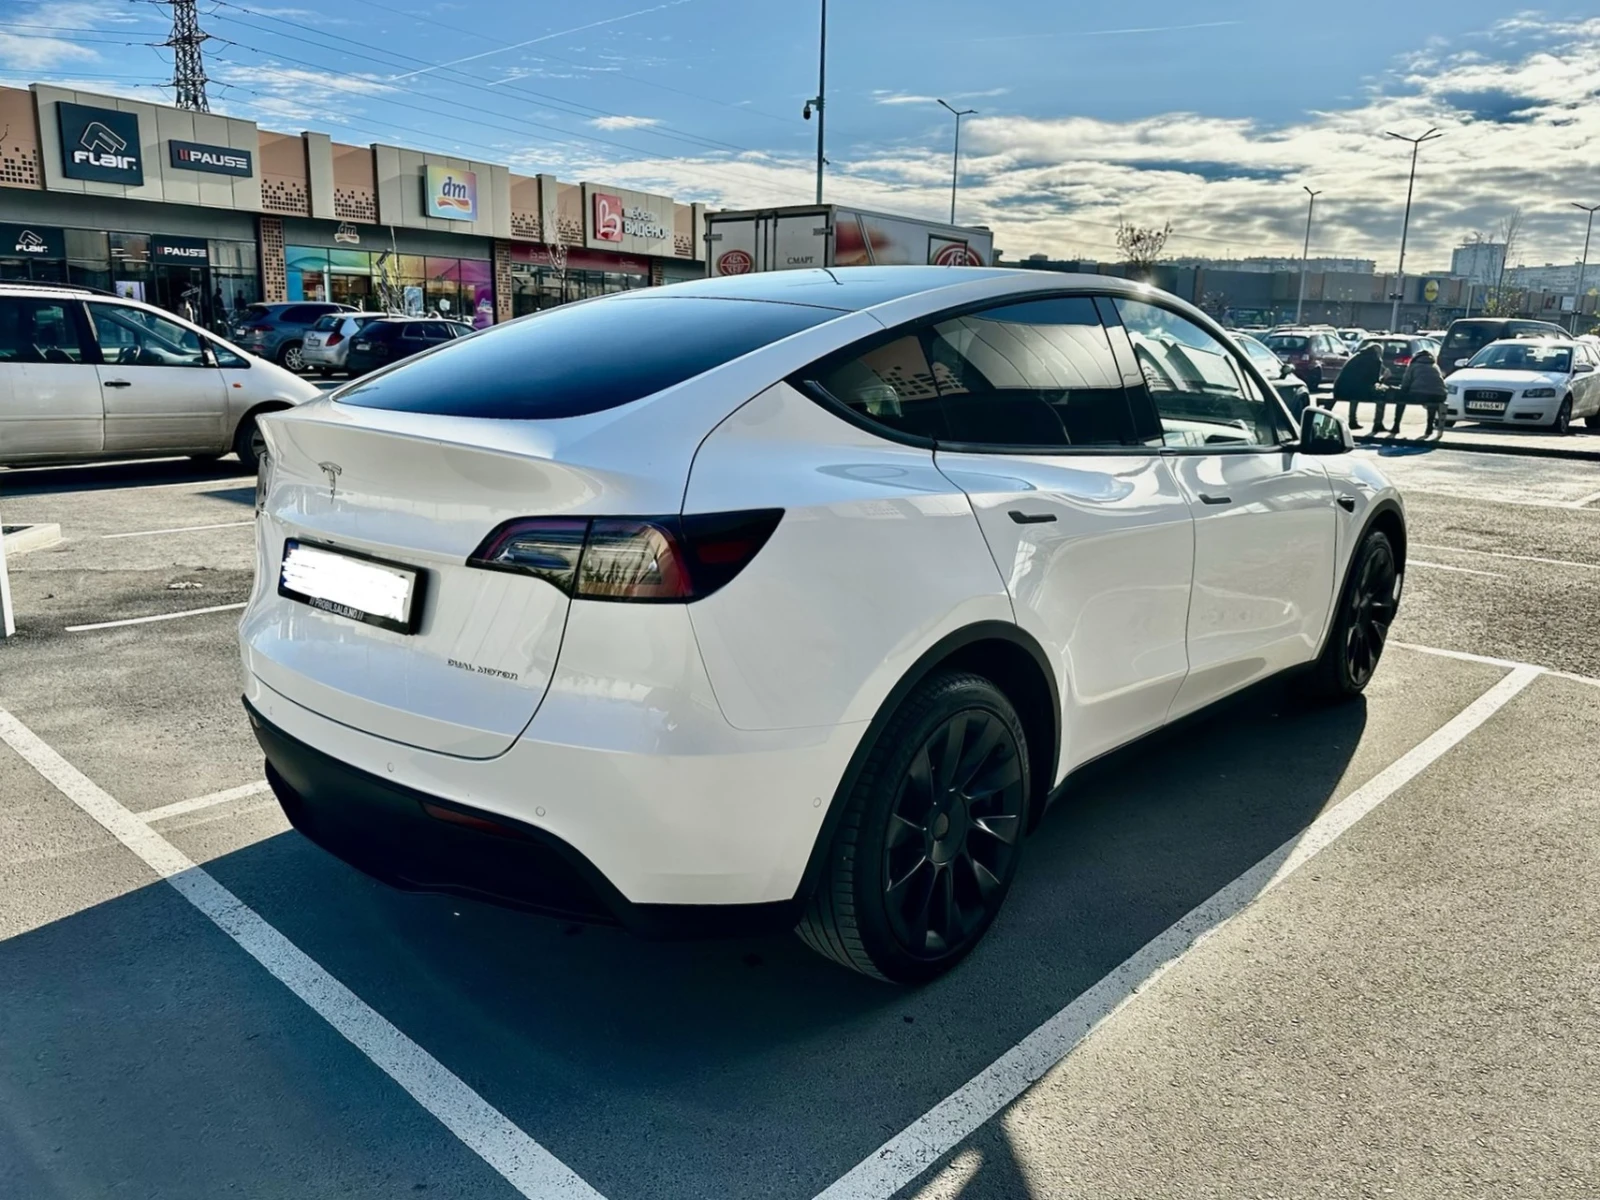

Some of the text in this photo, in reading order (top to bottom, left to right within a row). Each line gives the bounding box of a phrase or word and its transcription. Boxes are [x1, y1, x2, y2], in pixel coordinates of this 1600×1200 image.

[190, 150, 248, 169] PAUSE
[442, 176, 467, 199] dm
[163, 246, 207, 258] PAUSE
[448, 659, 518, 680] DUAL MOTOR
